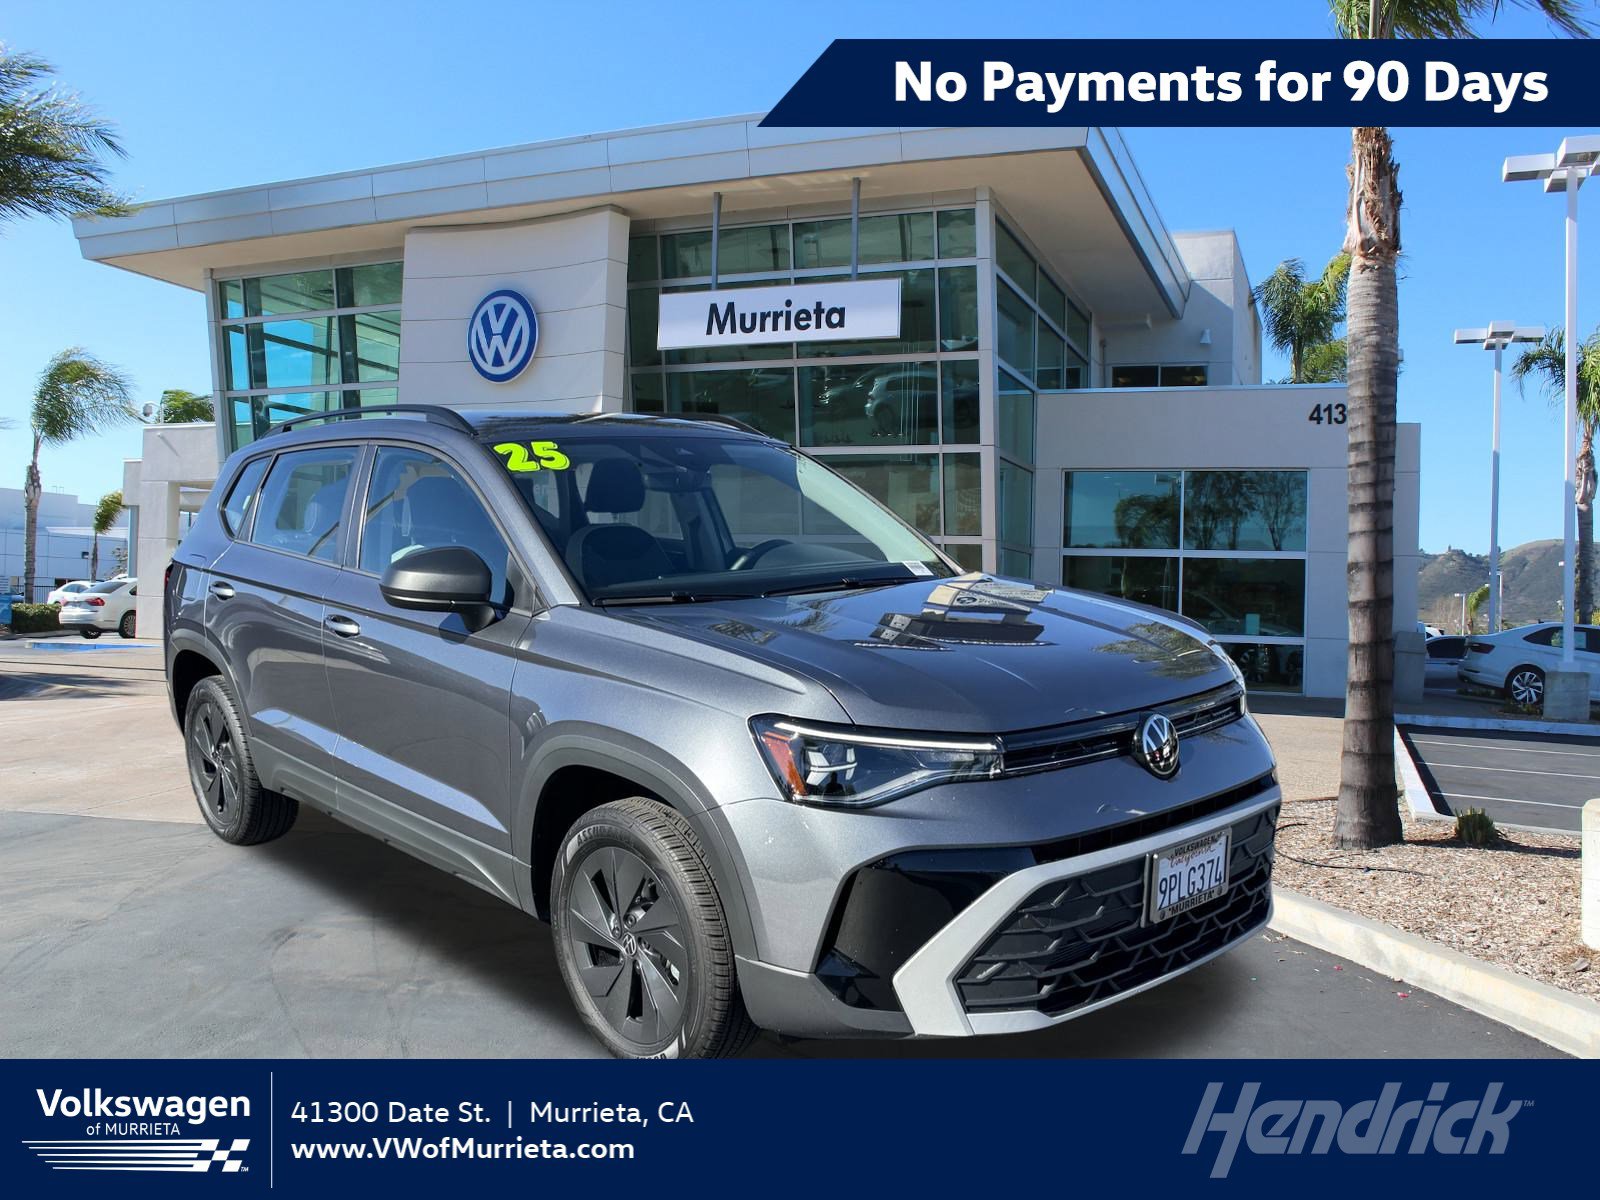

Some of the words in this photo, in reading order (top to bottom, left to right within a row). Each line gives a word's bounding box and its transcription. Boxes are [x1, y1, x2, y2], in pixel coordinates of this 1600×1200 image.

[705, 298, 846, 336] Murrieta
[494, 441, 570, 472] 25
[1158, 855, 1223, 911] 9PLG374
